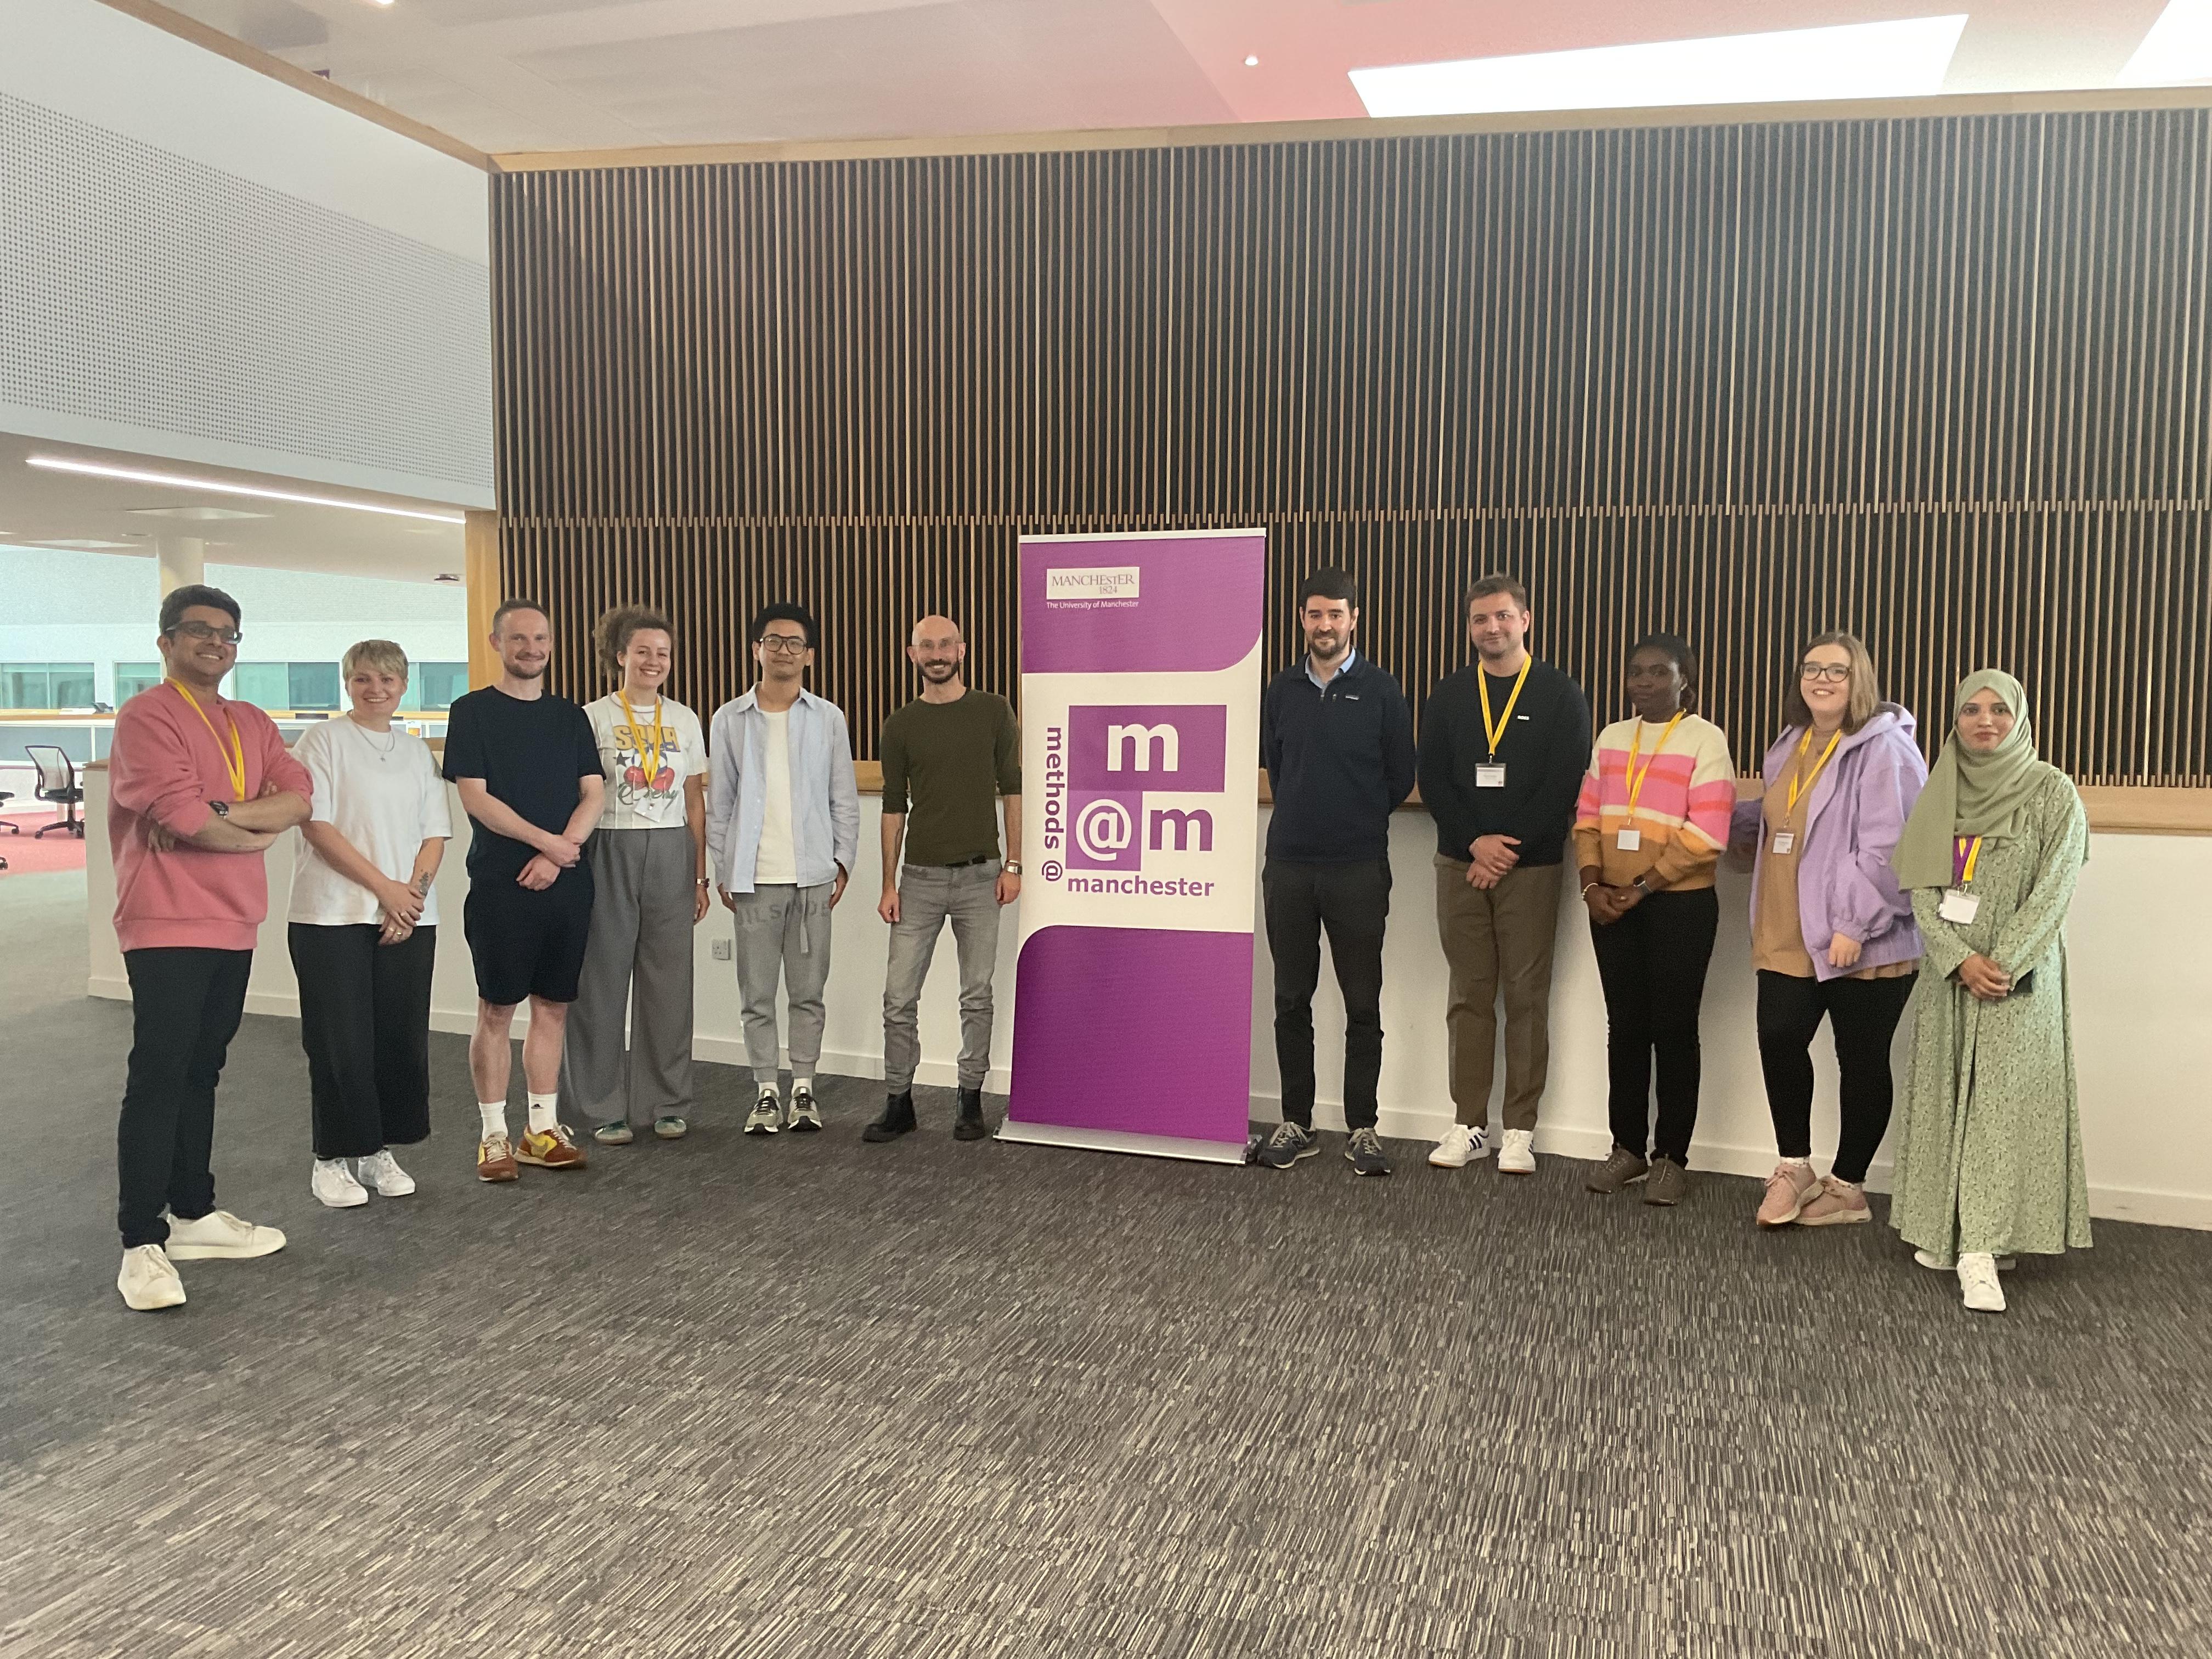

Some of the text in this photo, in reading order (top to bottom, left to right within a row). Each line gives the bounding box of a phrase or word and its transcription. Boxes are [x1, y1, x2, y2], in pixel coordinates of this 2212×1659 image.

[1051, 574, 1135, 586] MANCHESTER
[1098, 585, 1118, 595] 1824
[1059, 601, 1092, 610] University
[1107, 724, 1179, 772] m
[1041, 727, 1065, 882] methods @
[1068, 875, 1215, 896] manchester
